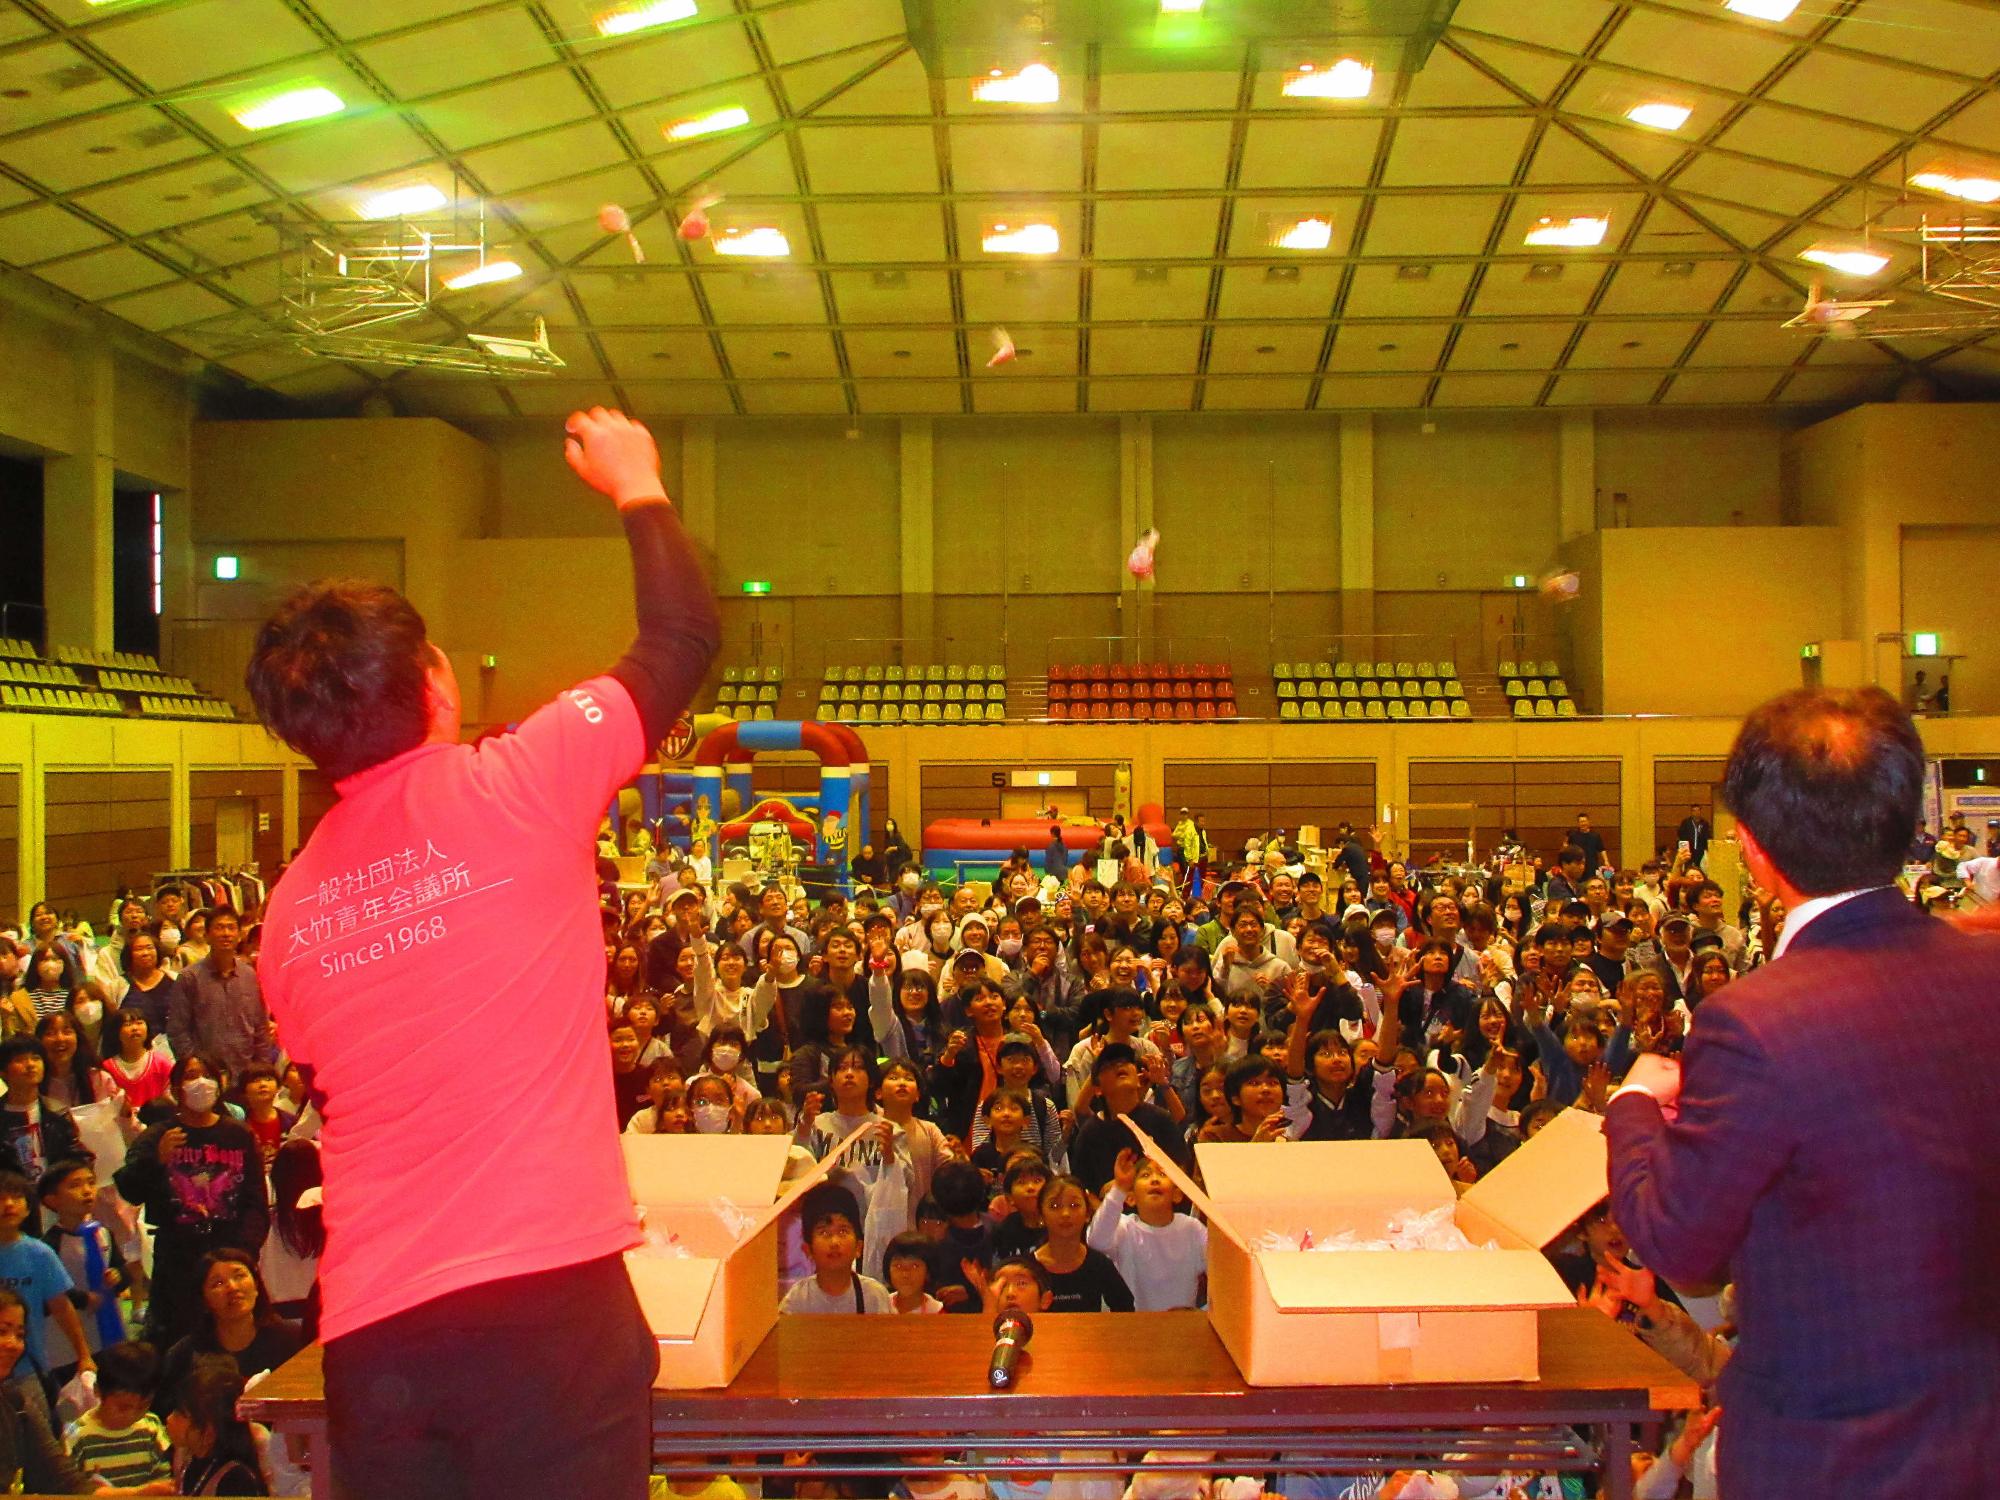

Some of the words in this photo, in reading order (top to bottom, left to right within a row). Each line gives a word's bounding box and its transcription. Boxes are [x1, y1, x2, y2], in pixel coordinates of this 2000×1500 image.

[288, 860, 471, 954] 大竹青年会議所
[295, 838, 448, 907] 一般社団法人
[319, 914, 448, 979] Since1968
